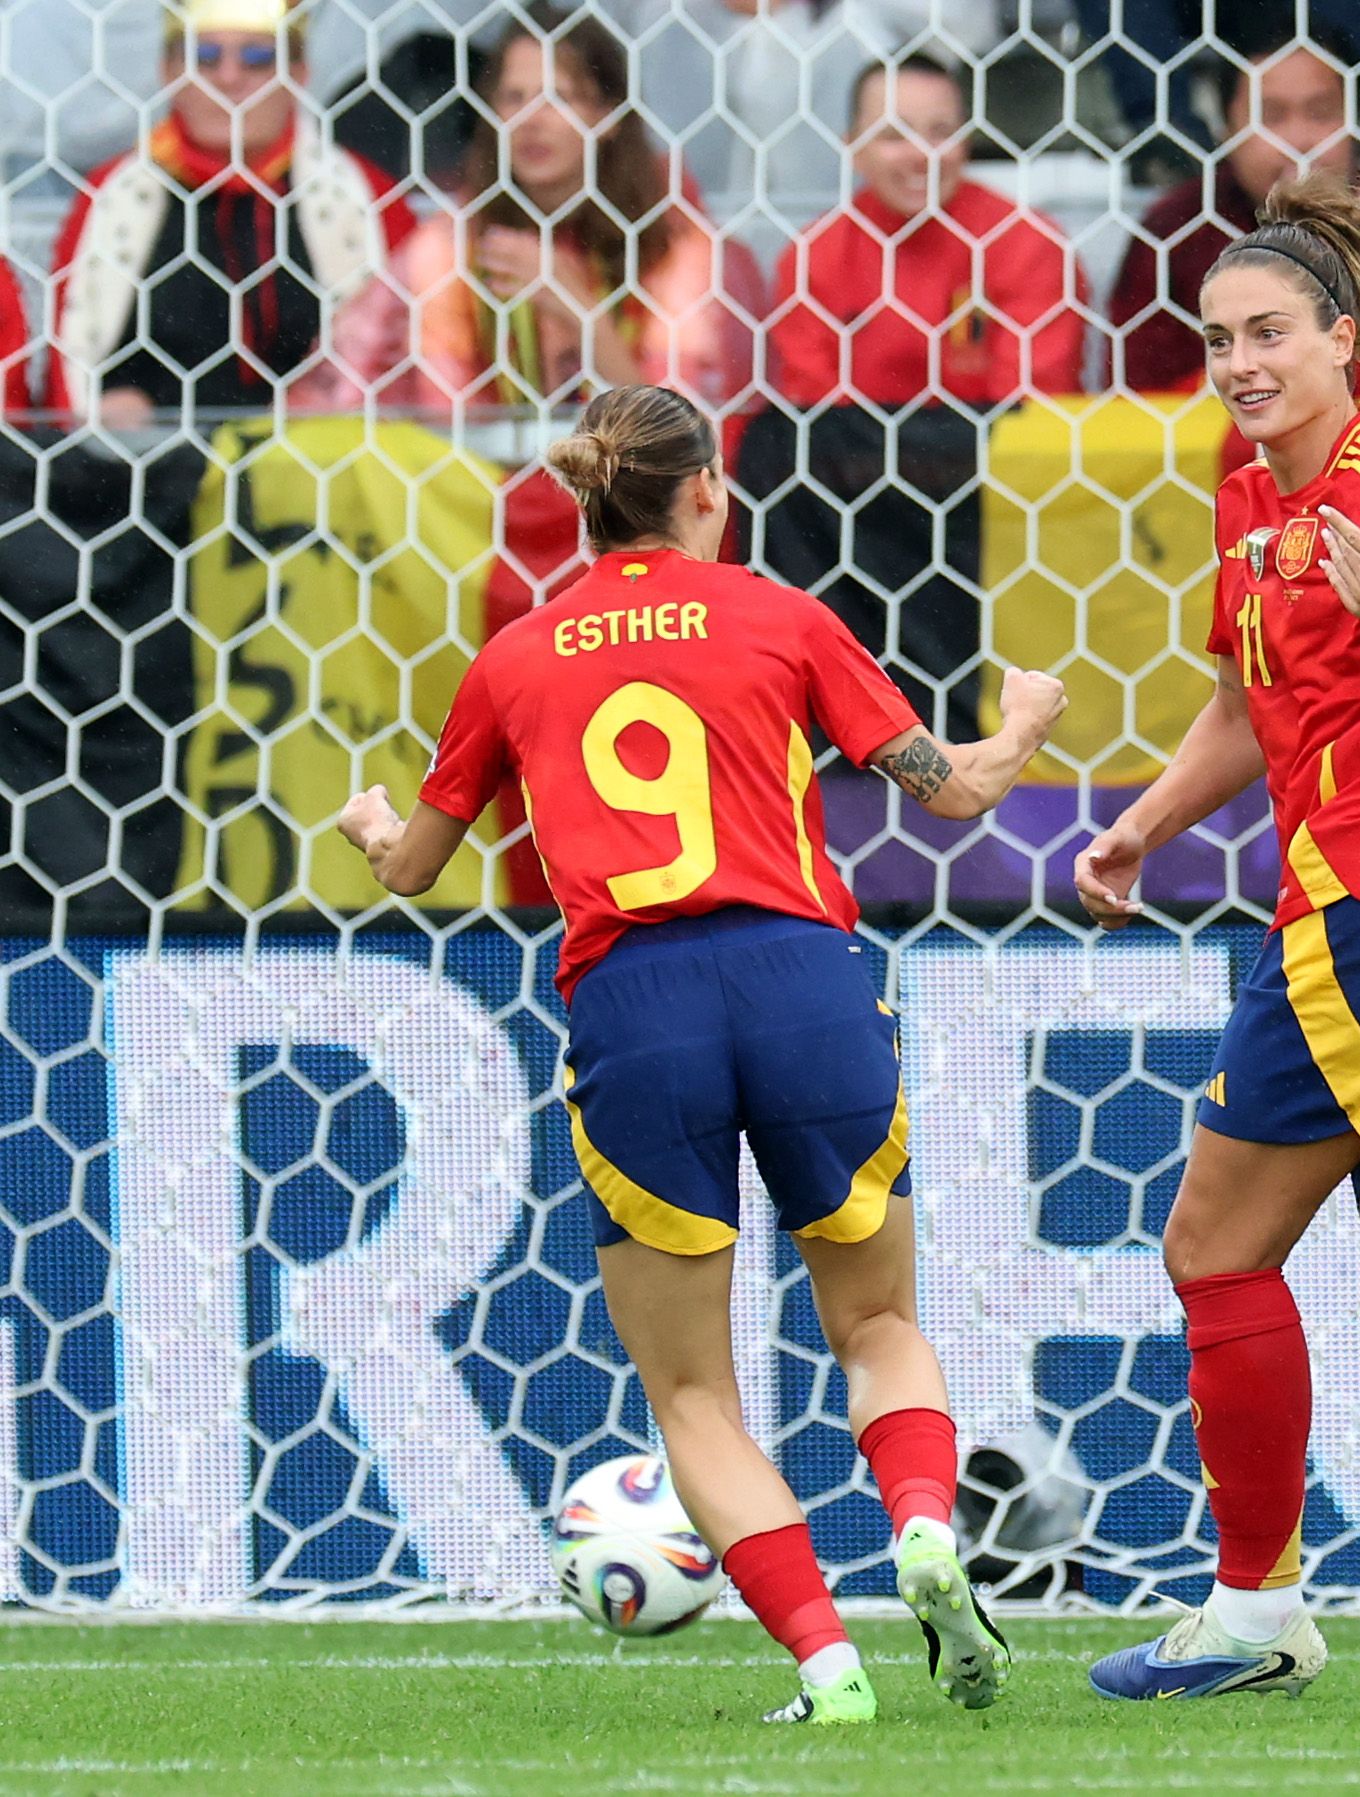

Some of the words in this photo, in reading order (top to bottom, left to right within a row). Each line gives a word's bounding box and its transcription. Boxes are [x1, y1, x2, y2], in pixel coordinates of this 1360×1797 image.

[554, 601, 709, 657] ESTHER
[1236, 593, 1273, 688] 11
[581, 680, 718, 912] 9
